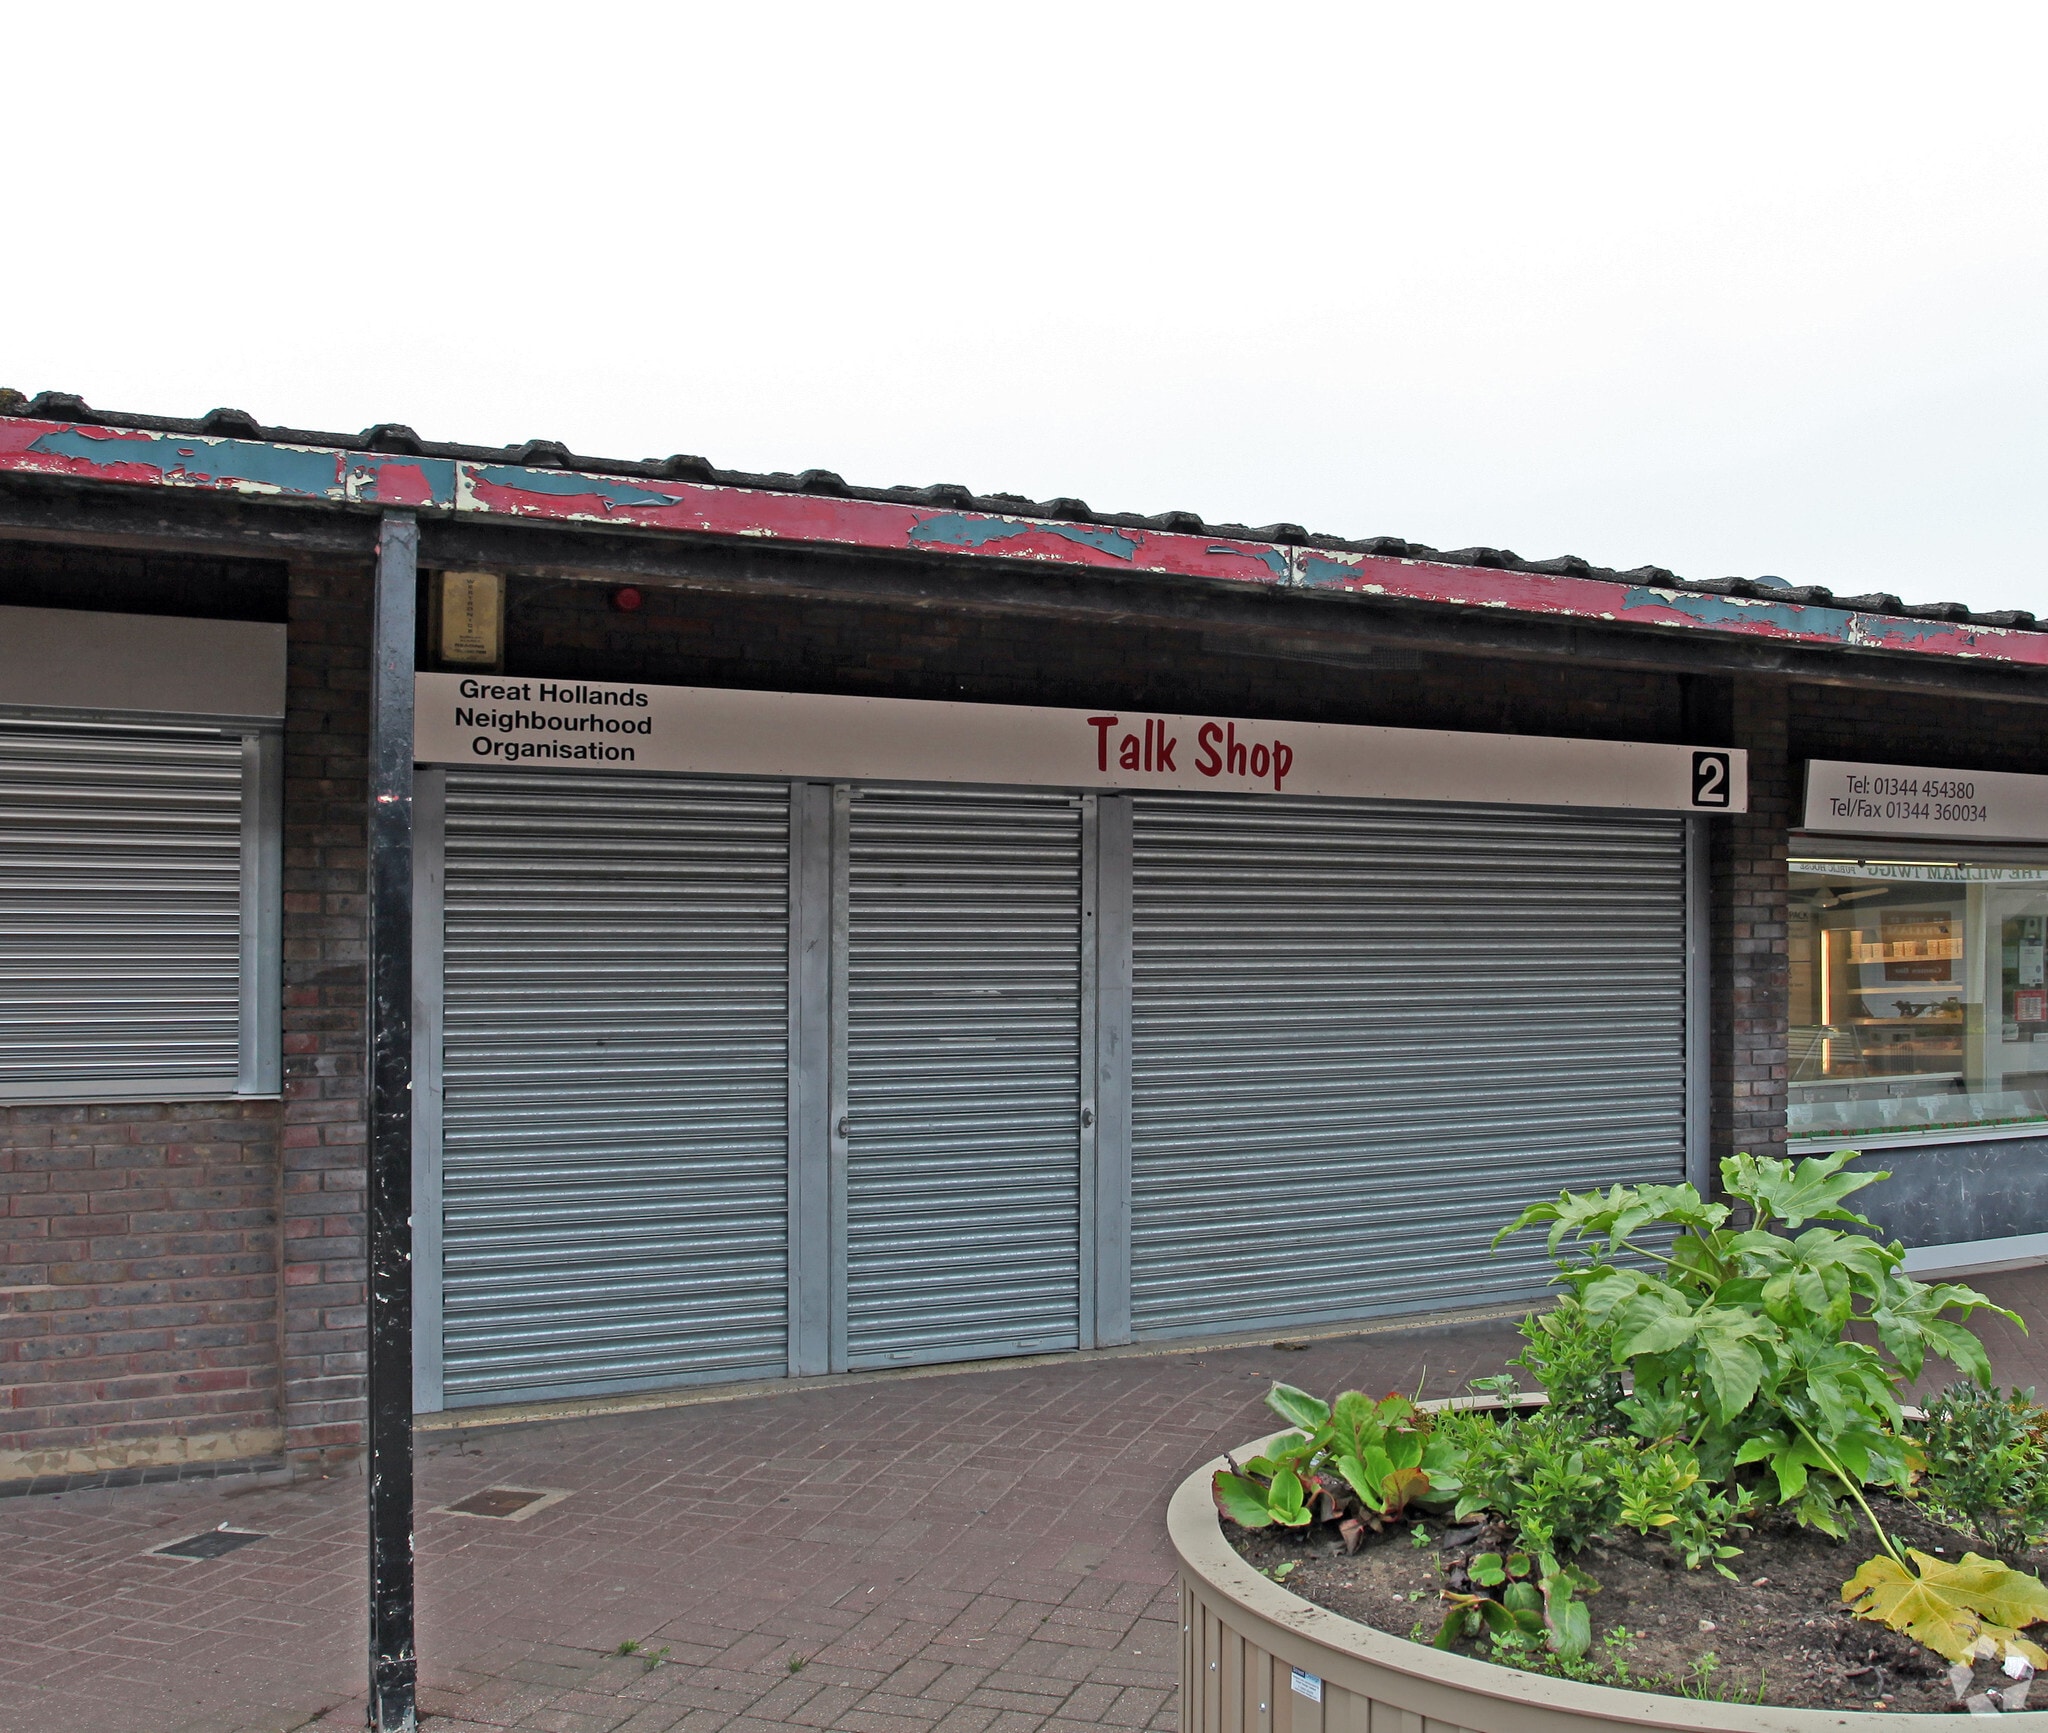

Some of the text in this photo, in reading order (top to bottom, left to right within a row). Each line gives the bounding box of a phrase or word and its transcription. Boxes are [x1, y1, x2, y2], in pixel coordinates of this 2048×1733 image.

[459, 679, 649, 707] Great Hollands
[455, 707, 652, 735] Neighbourhood
[472, 736, 635, 761] Organisation
[1087, 716, 1293, 792] Talk Shop
[1697, 757, 1725, 803] 2
[1846, 775, 1975, 799] Tel: 01344 454380
[1829, 797, 1987, 823] Tel/Fax 01344 360034
